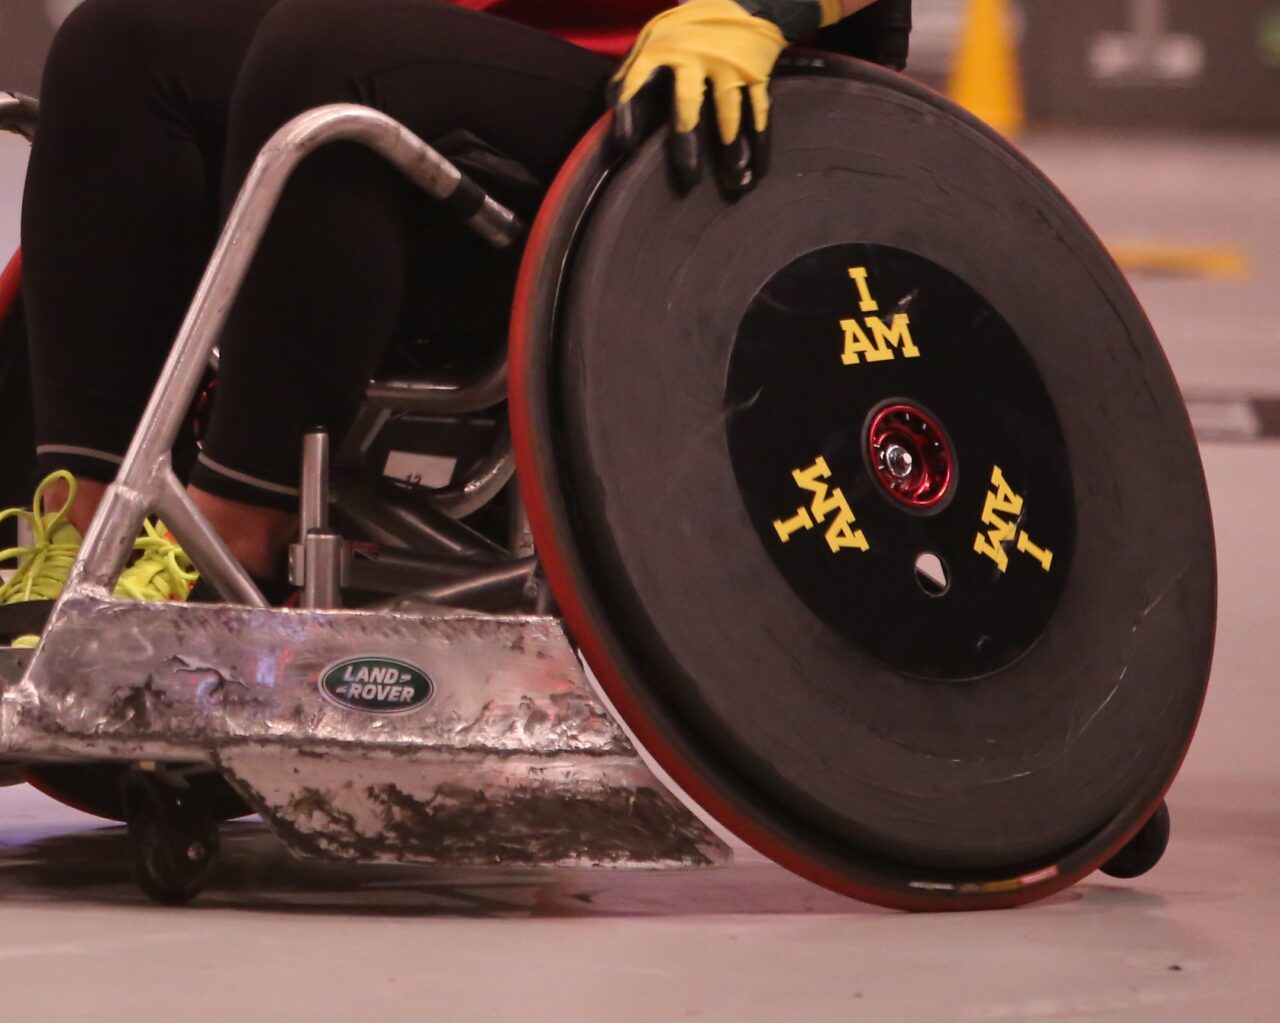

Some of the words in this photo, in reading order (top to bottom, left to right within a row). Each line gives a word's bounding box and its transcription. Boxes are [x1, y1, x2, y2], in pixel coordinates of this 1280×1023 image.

[848, 266, 879, 312] I
[839, 312, 921, 366] AM
[772, 505, 813, 543] I
[791, 455, 870, 554] AM
[973, 464, 1025, 574] AM
[1016, 528, 1054, 574] I
[344, 665, 399, 684] LAND
[347, 683, 415, 703] ROVER
